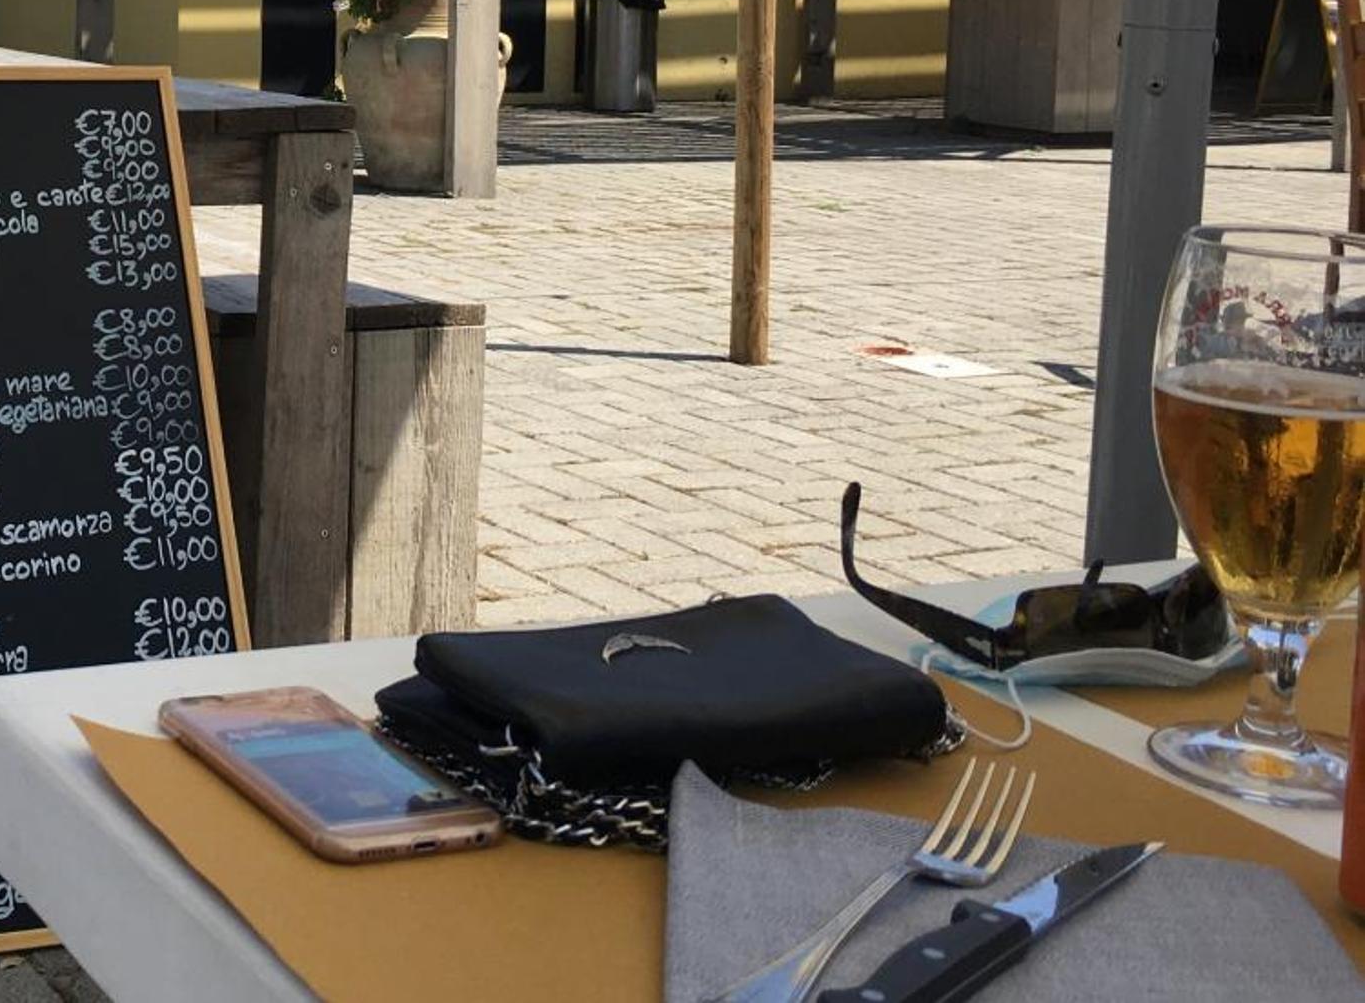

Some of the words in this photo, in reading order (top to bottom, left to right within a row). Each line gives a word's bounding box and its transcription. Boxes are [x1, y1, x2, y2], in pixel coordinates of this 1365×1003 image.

[74, 109, 152, 144] €7,00
[74, 136, 156, 166] €9,00
[81, 158, 159, 185] €9,00
[11, 189, 28, 208] e
[37, 178, 104, 207] carote
[87, 208, 165, 235] €11,00
[88, 233, 172, 259] €15,00
[85, 260, 178, 290] €13,00
[94, 306, 176, 336] €8,00
[93, 333, 183, 361] €8,00
[6, 372, 75, 395] mare
[93, 363, 192, 391] €10,00
[110, 418, 199, 448] €9,00
[114, 445, 203, 480] €9,50
[117, 476, 209, 504] €10,00
[0, 511, 112, 545] scamorza
[123, 501, 212, 537] €9,50
[123, 535, 218, 570] €11,00
[134, 597, 226, 628] €10,00
[134, 627, 230, 660] €12,00
